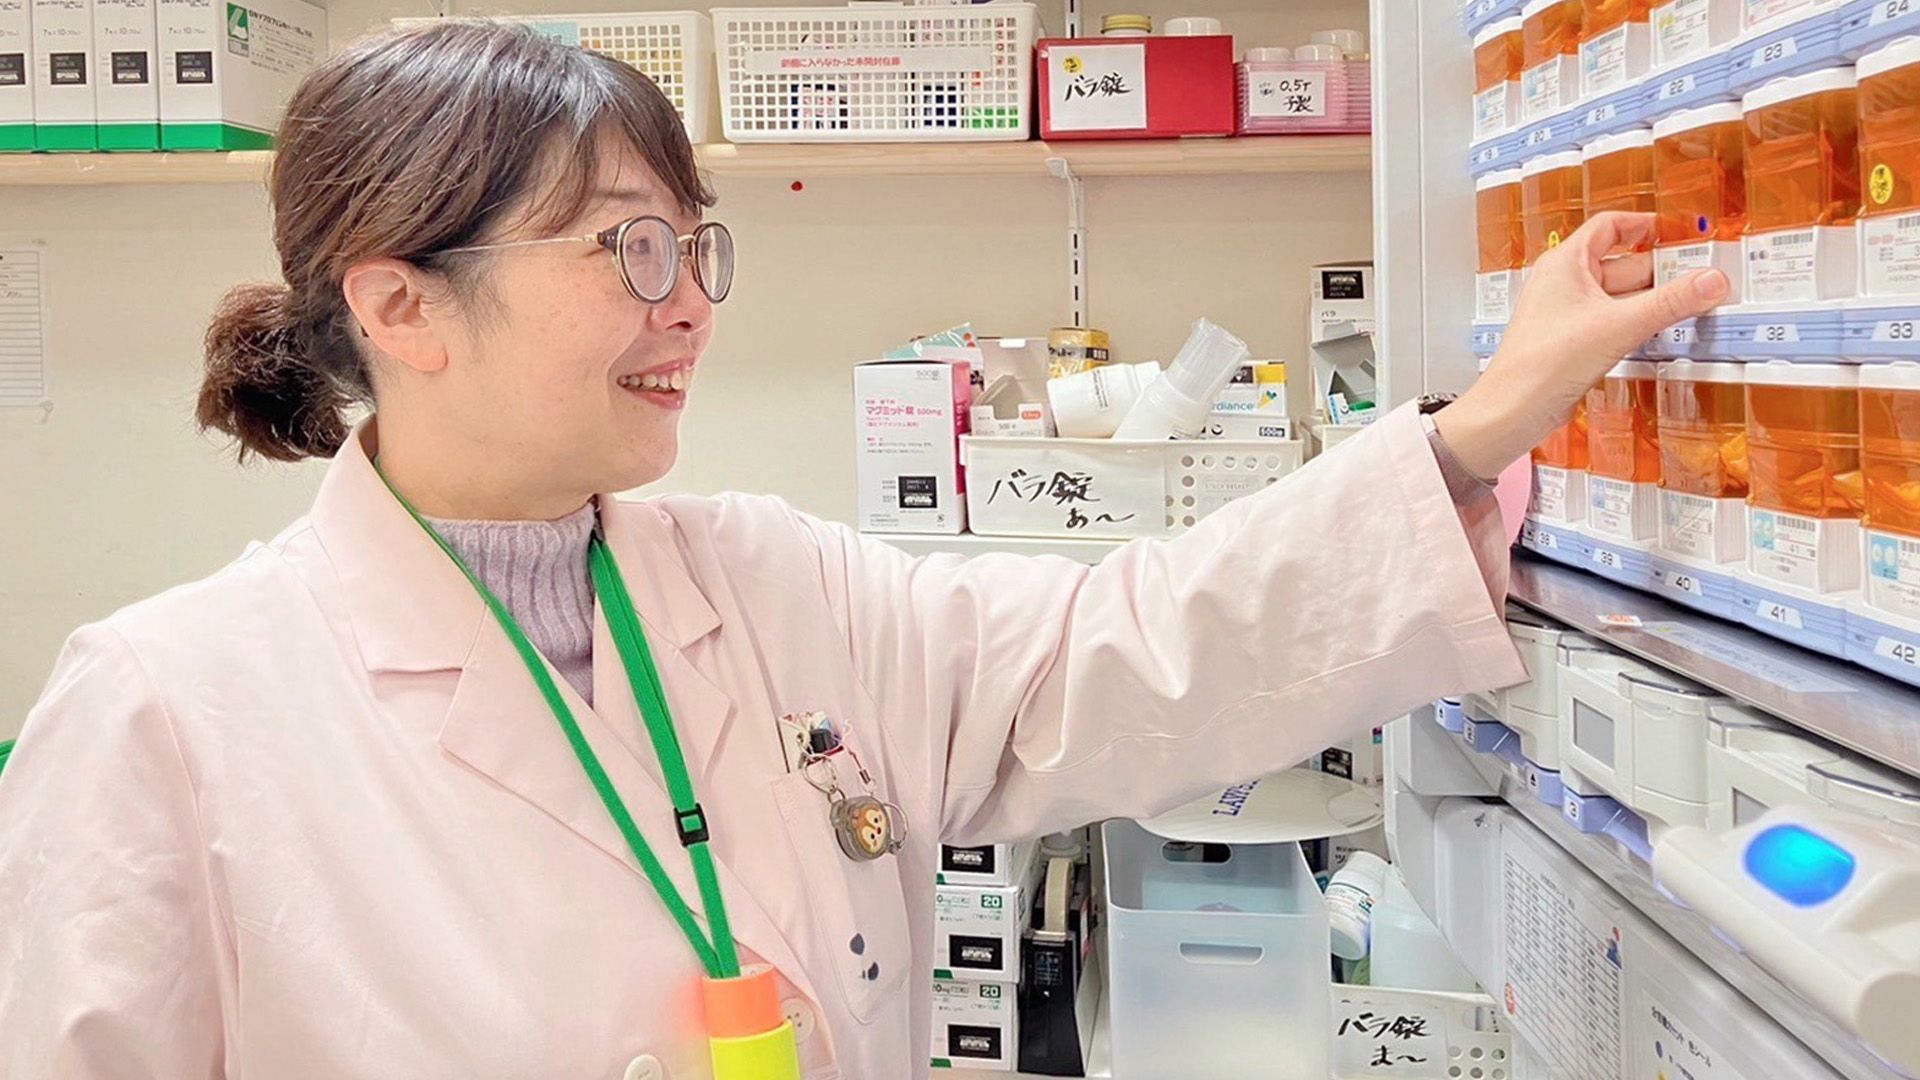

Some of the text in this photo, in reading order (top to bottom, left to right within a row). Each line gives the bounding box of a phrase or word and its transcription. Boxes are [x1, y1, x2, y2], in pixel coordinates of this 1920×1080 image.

[1886, 0, 1908, 18] 24
[1763, 43, 1783, 62] 23
[1064, 72, 1133, 102] バラ錠
[1668, 79, 1684, 96] 22
[1594, 107, 1606, 121] 21
[1533, 130, 1545, 144] 20
[1673, 329, 1686, 342] 31
[1766, 326, 1785, 341] 32
[1889, 322, 1913, 339] 33
[987, 468, 1101, 505] バラ錠
[1601, 551, 1613, 566] 39
[1675, 576, 1691, 591] 40
[1771, 605, 1787, 622] 41
[1892, 644, 1916, 664] 42
[982, 895, 1002, 908] 20
[981, 986, 1000, 998] 20
[1338, 1012, 1431, 1040] バラ錠
